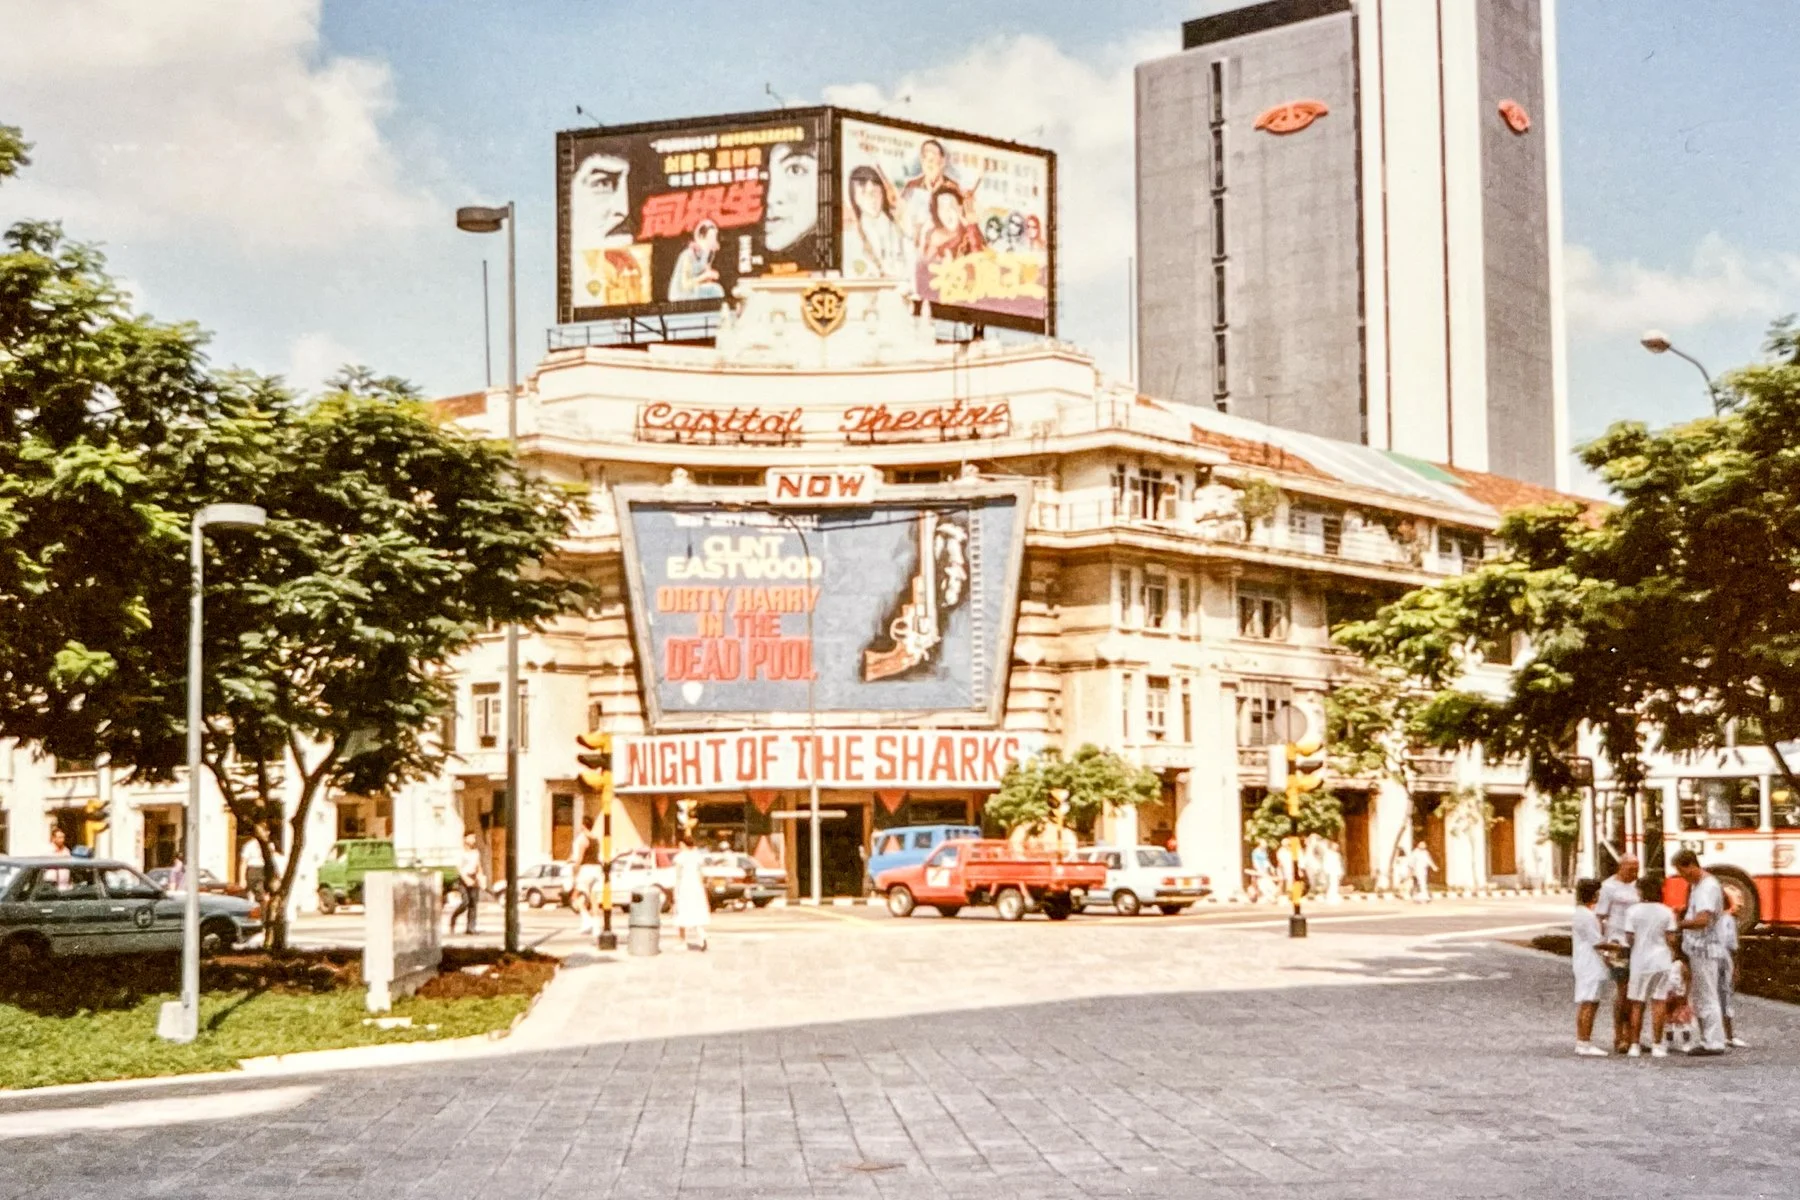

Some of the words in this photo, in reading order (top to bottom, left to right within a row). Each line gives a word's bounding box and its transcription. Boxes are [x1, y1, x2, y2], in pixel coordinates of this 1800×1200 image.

[811, 293, 838, 319] SB
[643, 402, 803, 438] Capitol
[838, 398, 1008, 432] Theatre
[776, 475, 865, 498] NOW
[703, 535, 785, 559] CLINT
[666, 555, 823, 579] EASTWOOD
[656, 586, 732, 613] DIRTY
[735, 586, 821, 613] HARRY
[698, 612, 726, 638] IN
[733, 611, 782, 638] THE
[665, 637, 741, 682] DEAD
[746, 637, 820, 682] POOL
[626, 739, 728, 786] NIGHT
[736, 735, 779, 781] OF
[791, 735, 864, 781] THE
[875, 735, 1020, 782] SHARKS
